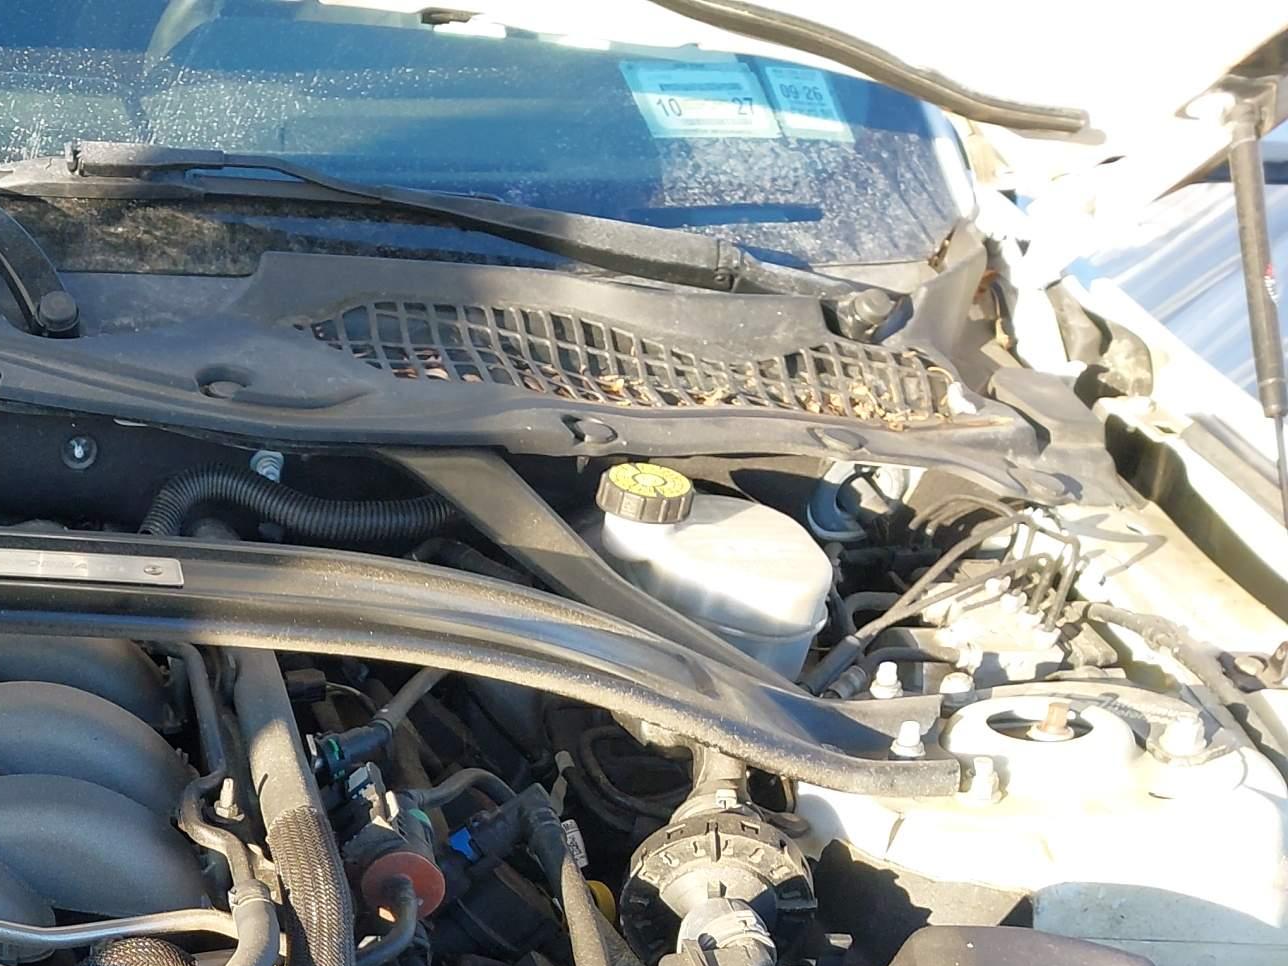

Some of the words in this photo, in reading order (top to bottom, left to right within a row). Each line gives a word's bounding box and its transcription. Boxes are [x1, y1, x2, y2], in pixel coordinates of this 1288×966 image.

[779, 83, 799, 100] 09
[803, 84, 823, 102] 26
[656, 97, 683, 118] 10
[731, 97, 754, 116] 27
